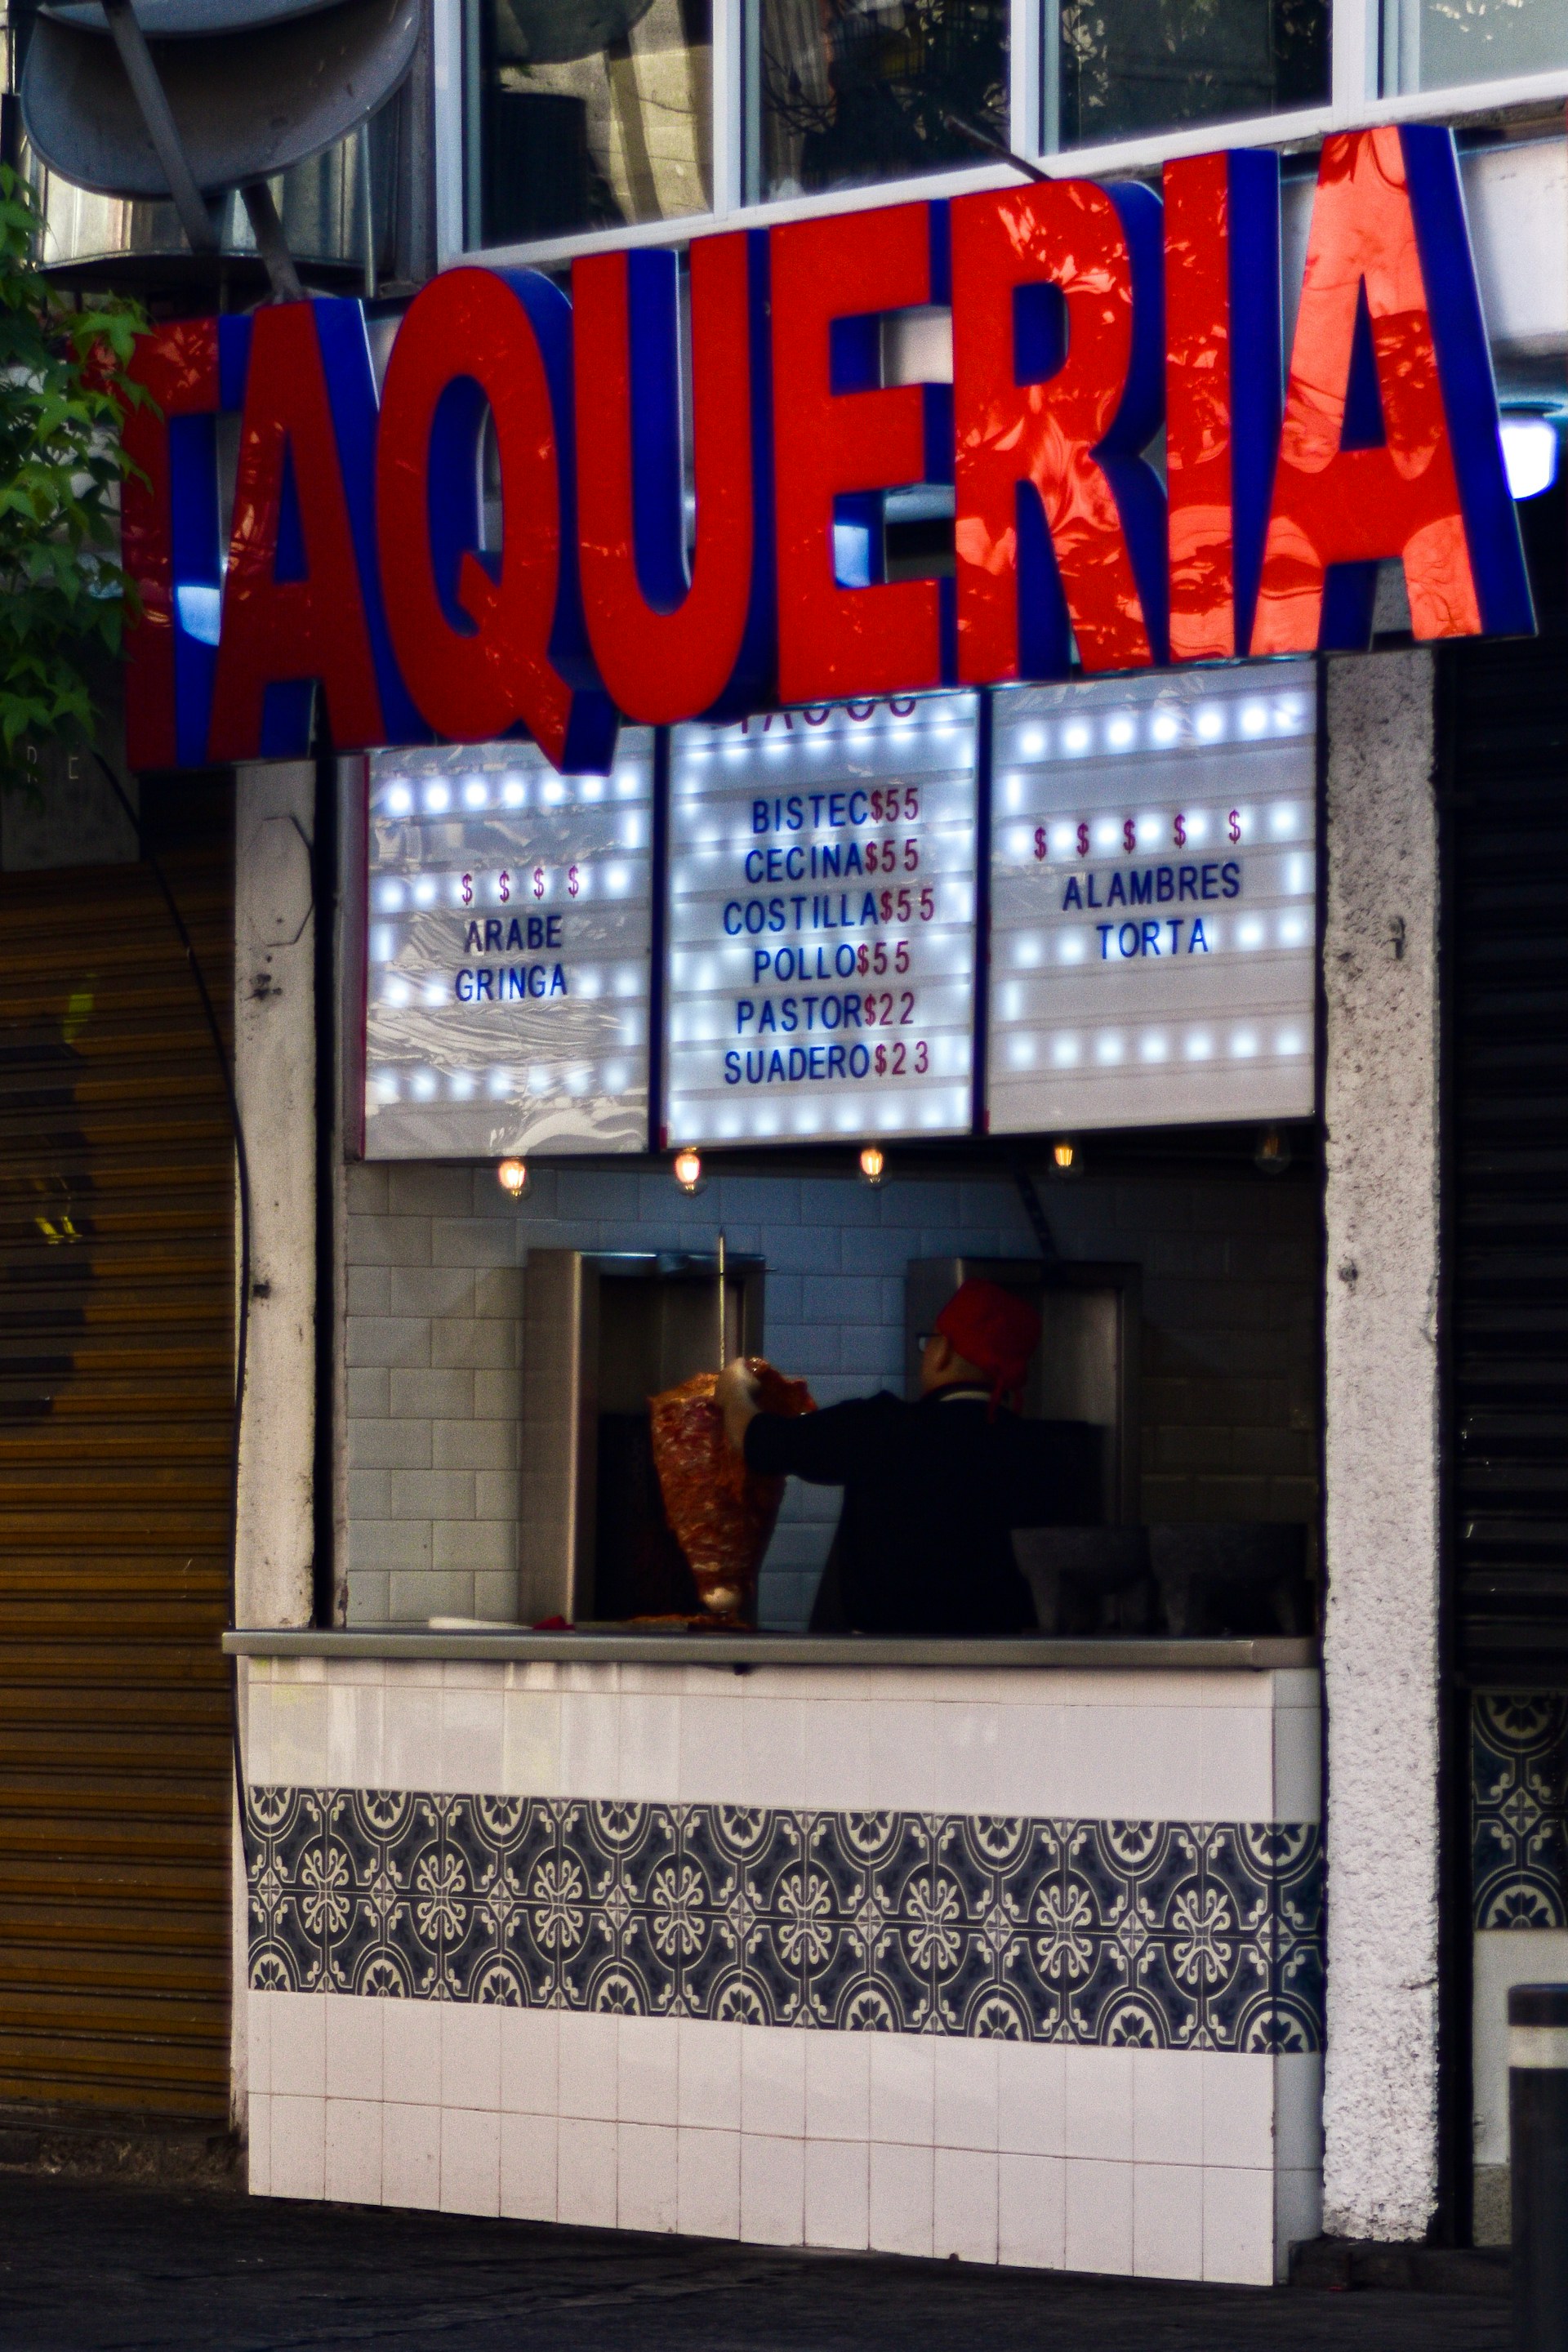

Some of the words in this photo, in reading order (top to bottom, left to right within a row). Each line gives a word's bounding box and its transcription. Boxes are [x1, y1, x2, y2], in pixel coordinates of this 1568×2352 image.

[69, 126, 1482, 775] TAQUERIA
[1062, 862, 1241, 911] ALAMBRES
[464, 915, 563, 954] ARABE
[1097, 917, 1209, 960] TORTA
[455, 963, 568, 1002] GRINGA
